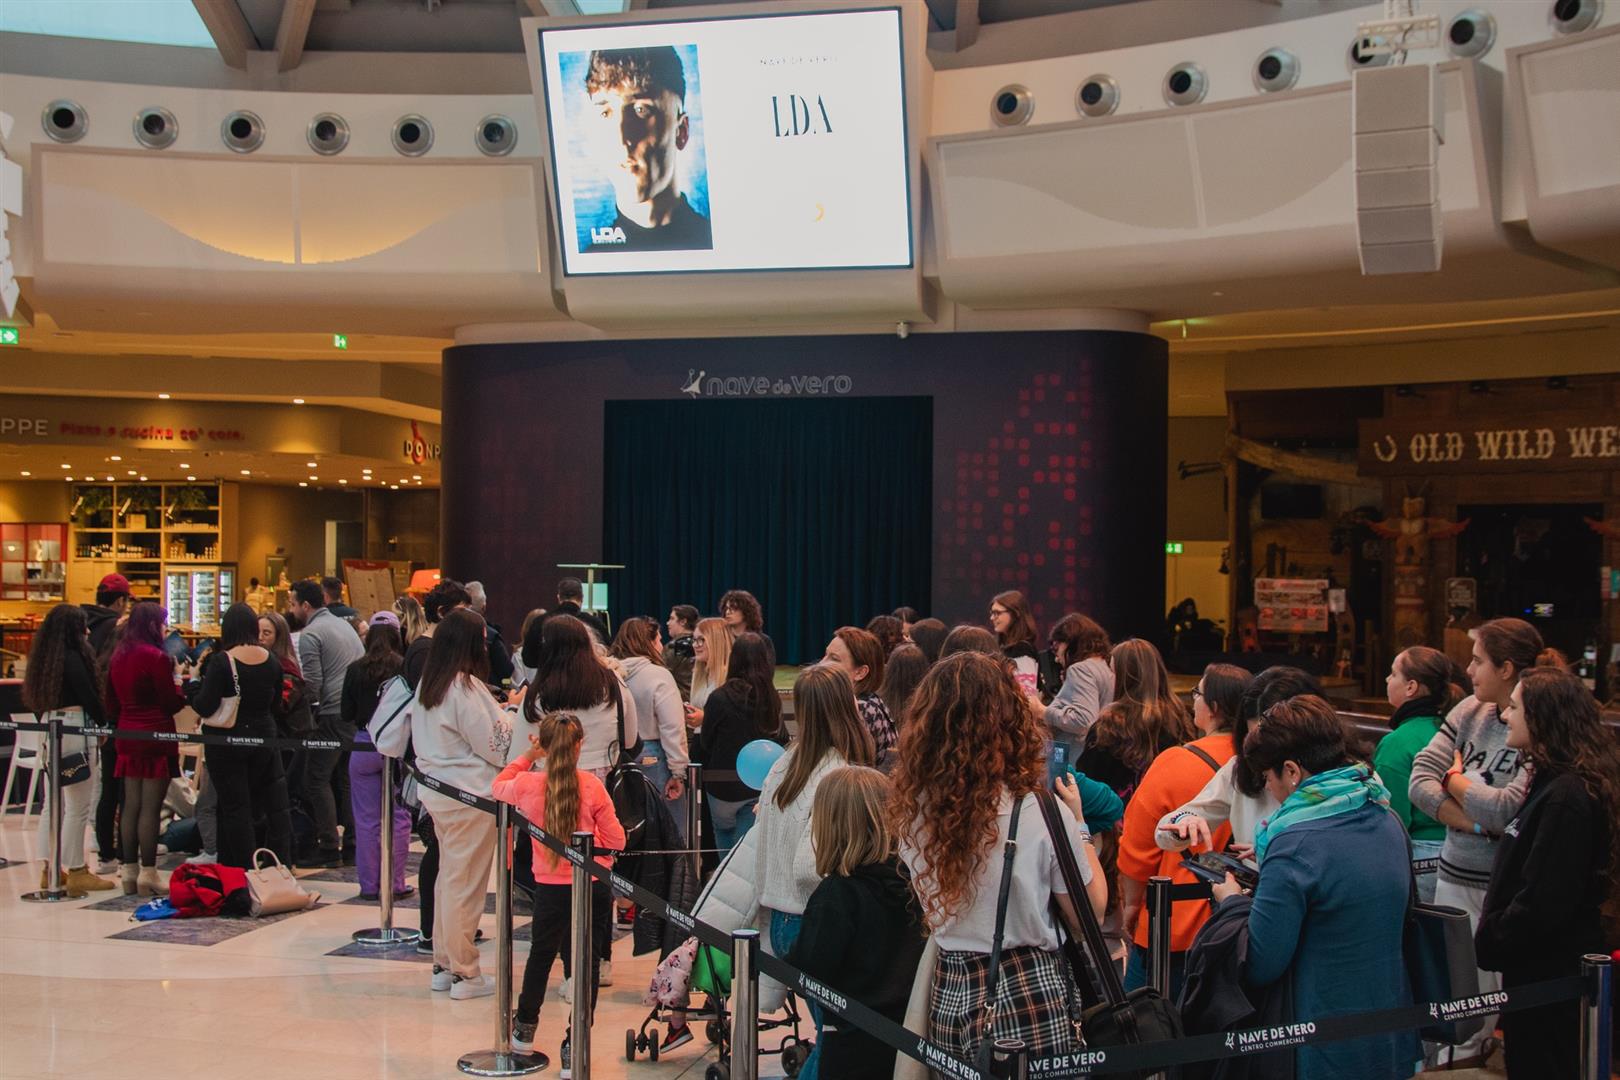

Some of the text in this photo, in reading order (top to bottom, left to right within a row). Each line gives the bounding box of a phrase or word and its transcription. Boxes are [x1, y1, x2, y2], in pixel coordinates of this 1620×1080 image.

[772, 94, 832, 137] LDA
[591, 226, 627, 241] LDA
[706, 375, 853, 396] nave de vero
[1, 419, 49, 436] PPE
[1410, 426, 1620, 463] OLD WILD WE
[805, 978, 847, 1010] NAVE DE VERO
[1440, 992, 1509, 1014] NAVE DE VERO
[1239, 1021, 1316, 1045] NAVE DE VERO
[1240, 1036, 1305, 1052] CENTRO COMMERCIALE
[926, 1044, 981, 1080] NAVE DE VERO
[1053, 1055, 1069, 1069] DE
[1071, 1050, 1106, 1066] VERO
[1045, 1066, 1092, 1079] COMMERCIALE
